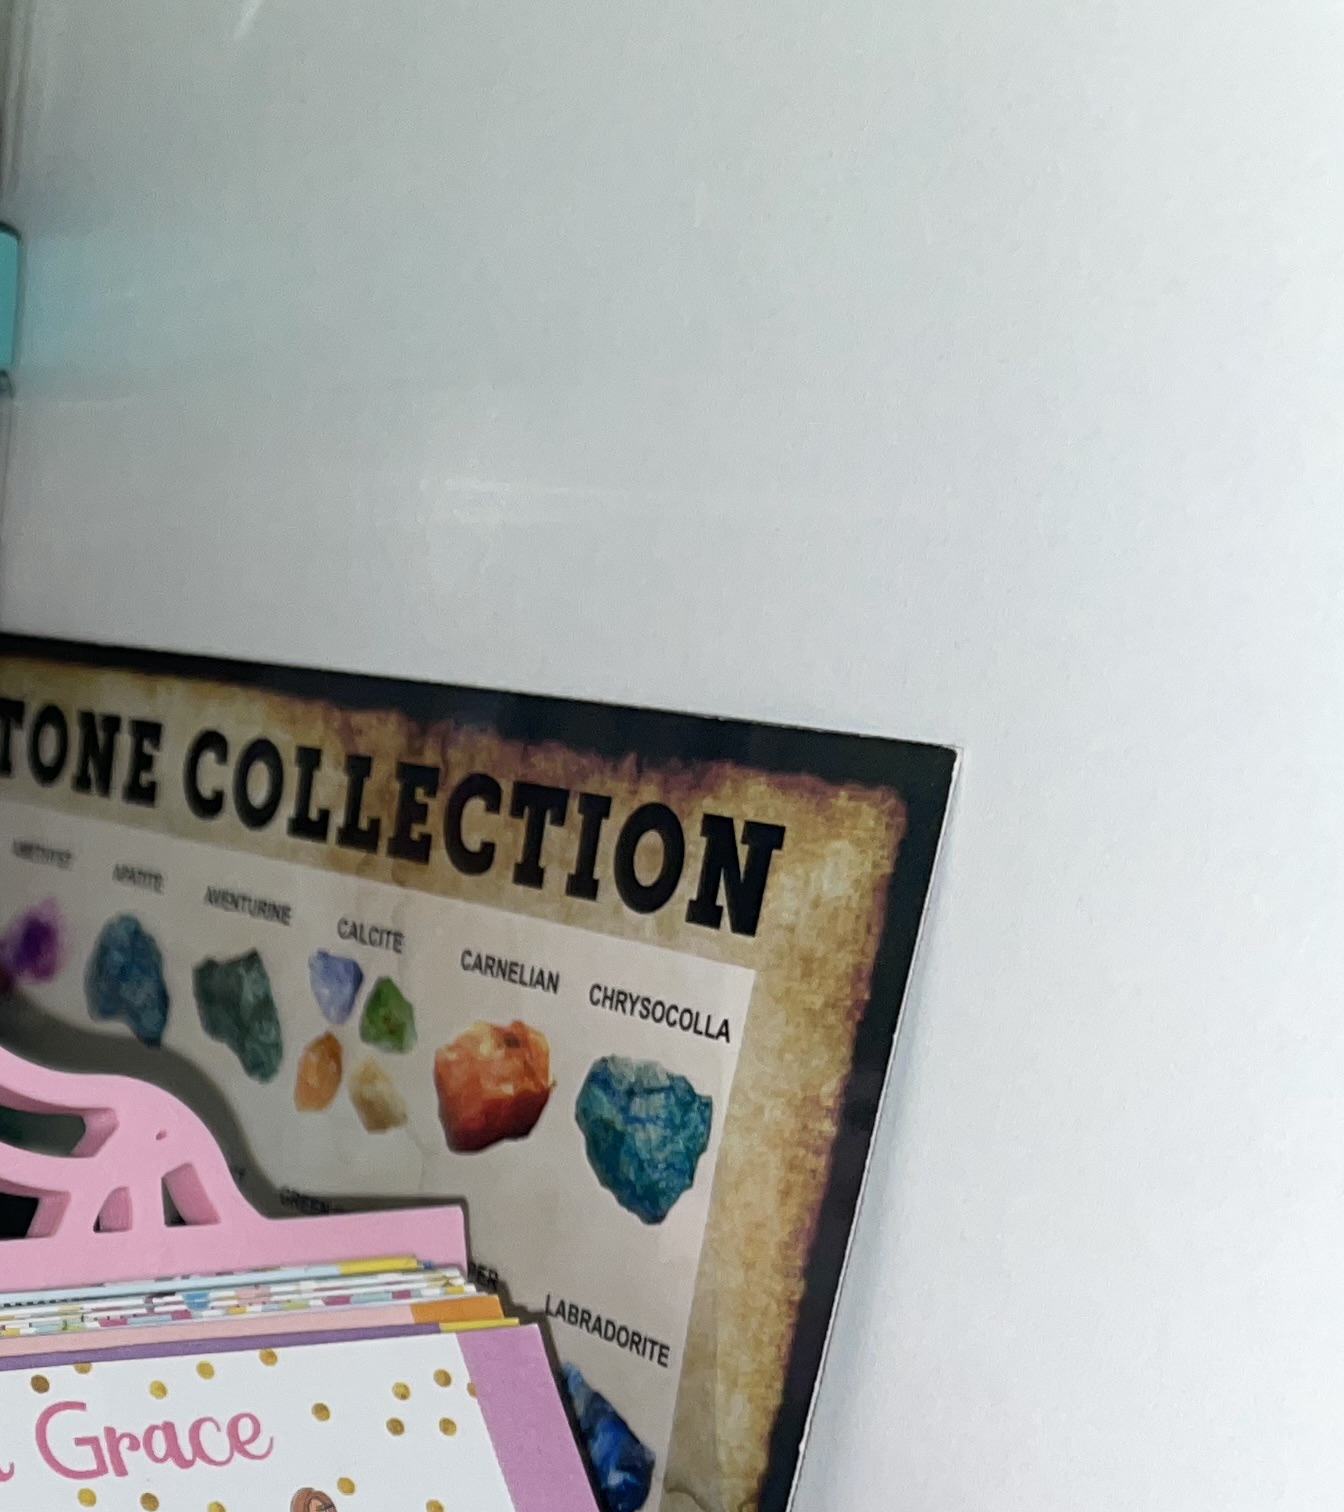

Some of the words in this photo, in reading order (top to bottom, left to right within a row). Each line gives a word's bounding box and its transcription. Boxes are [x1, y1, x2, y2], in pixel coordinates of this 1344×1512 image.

[183, 729, 786, 938] COLLECTION
[203, 885, 292, 926] AVENTURINE
[337, 916, 405, 954] CALCITE
[460, 949, 561, 995] CARNELIAN
[589, 983, 731, 1044] CHRYSOCOLLA
[545, 1292, 671, 1368] LABRADORITE
[34, 1400, 274, 1480] Grace
